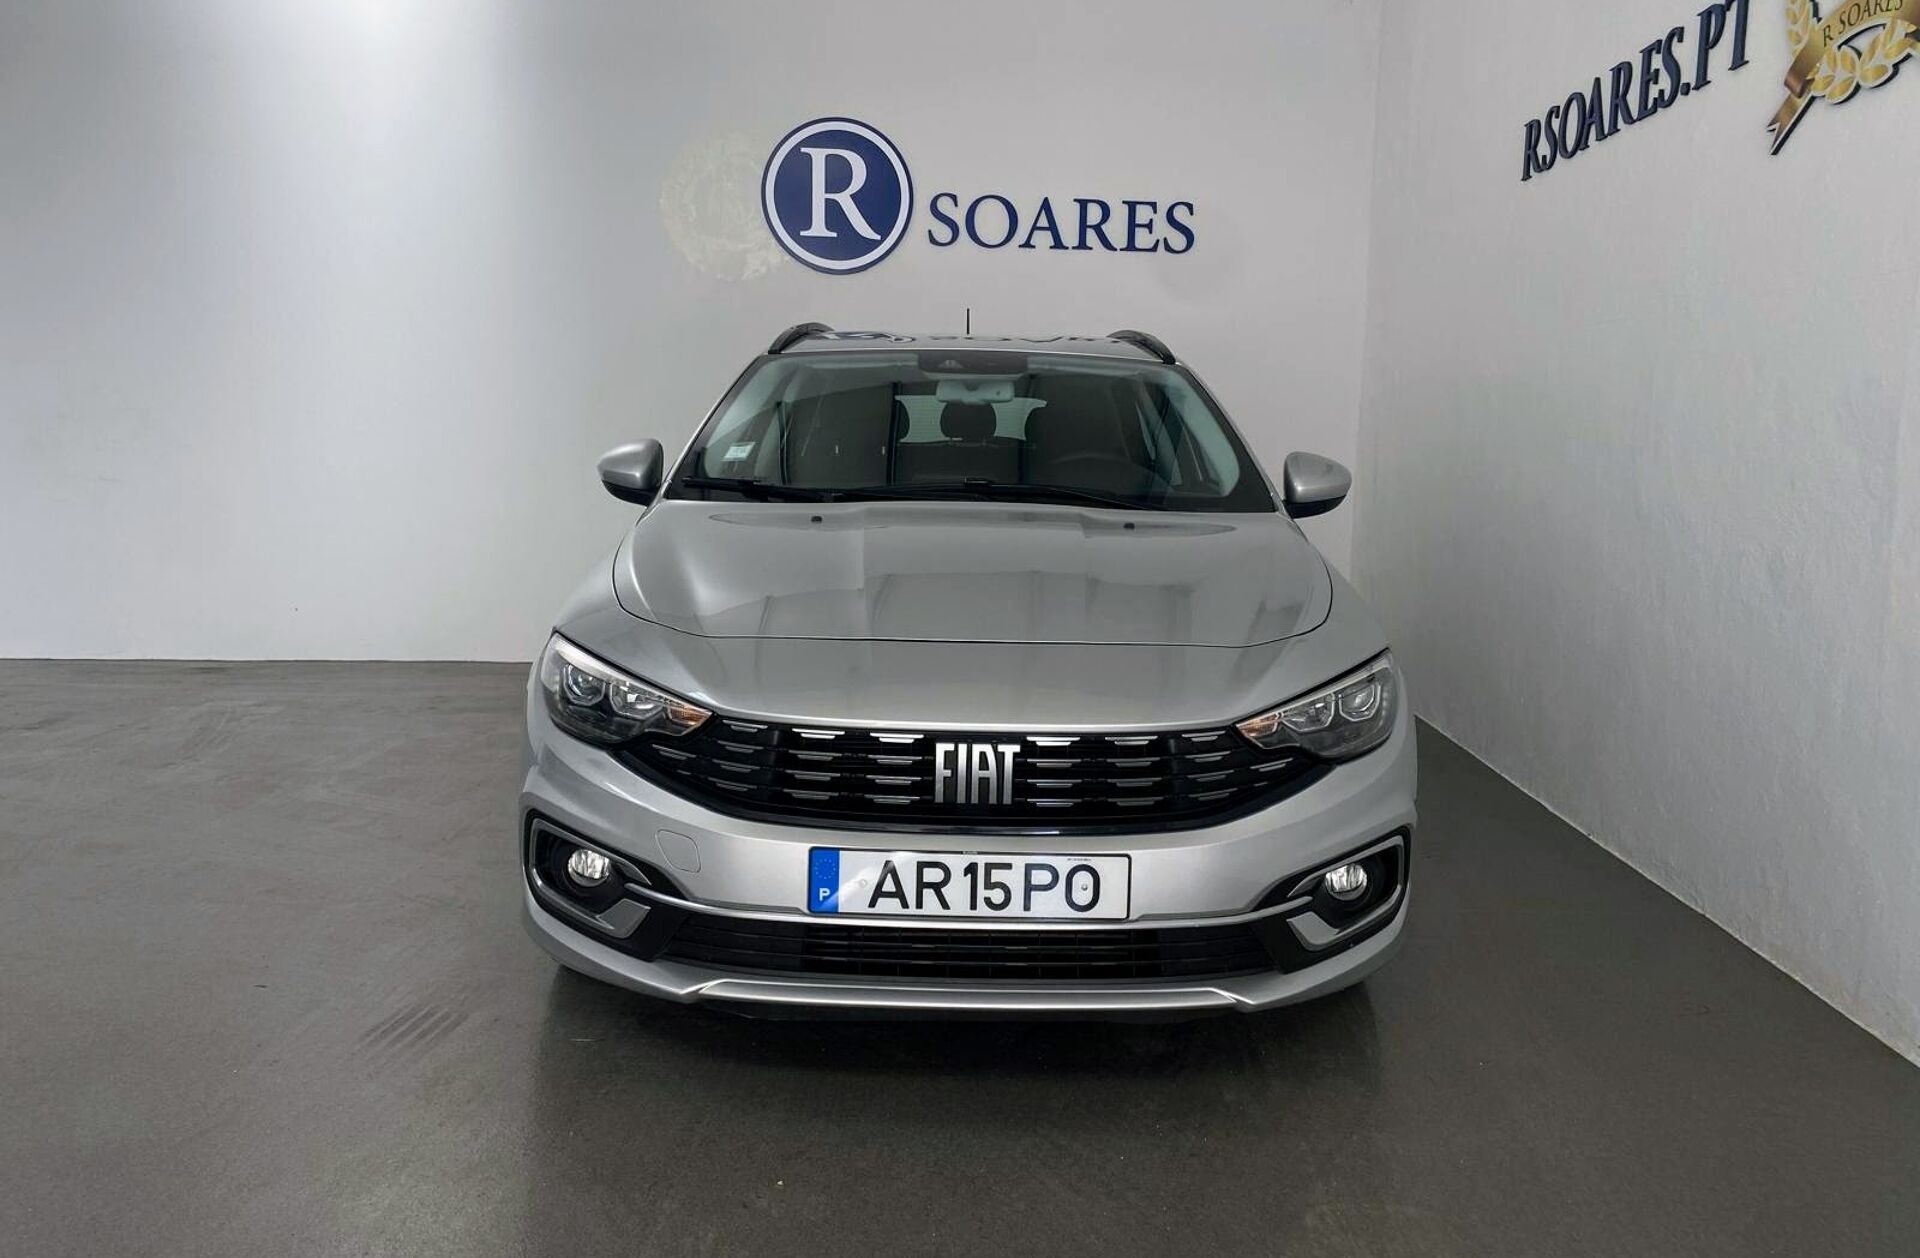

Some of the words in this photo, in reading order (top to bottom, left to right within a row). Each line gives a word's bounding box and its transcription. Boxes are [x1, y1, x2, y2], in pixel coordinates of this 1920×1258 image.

[1823, 25, 1834, 47] R
[1521, 0, 1749, 181] RSOARES.PT
[800, 147, 881, 240] R
[928, 193, 1195, 254] SOARES
[935, 743, 1021, 805] FIAT
[819, 888, 830, 902] P
